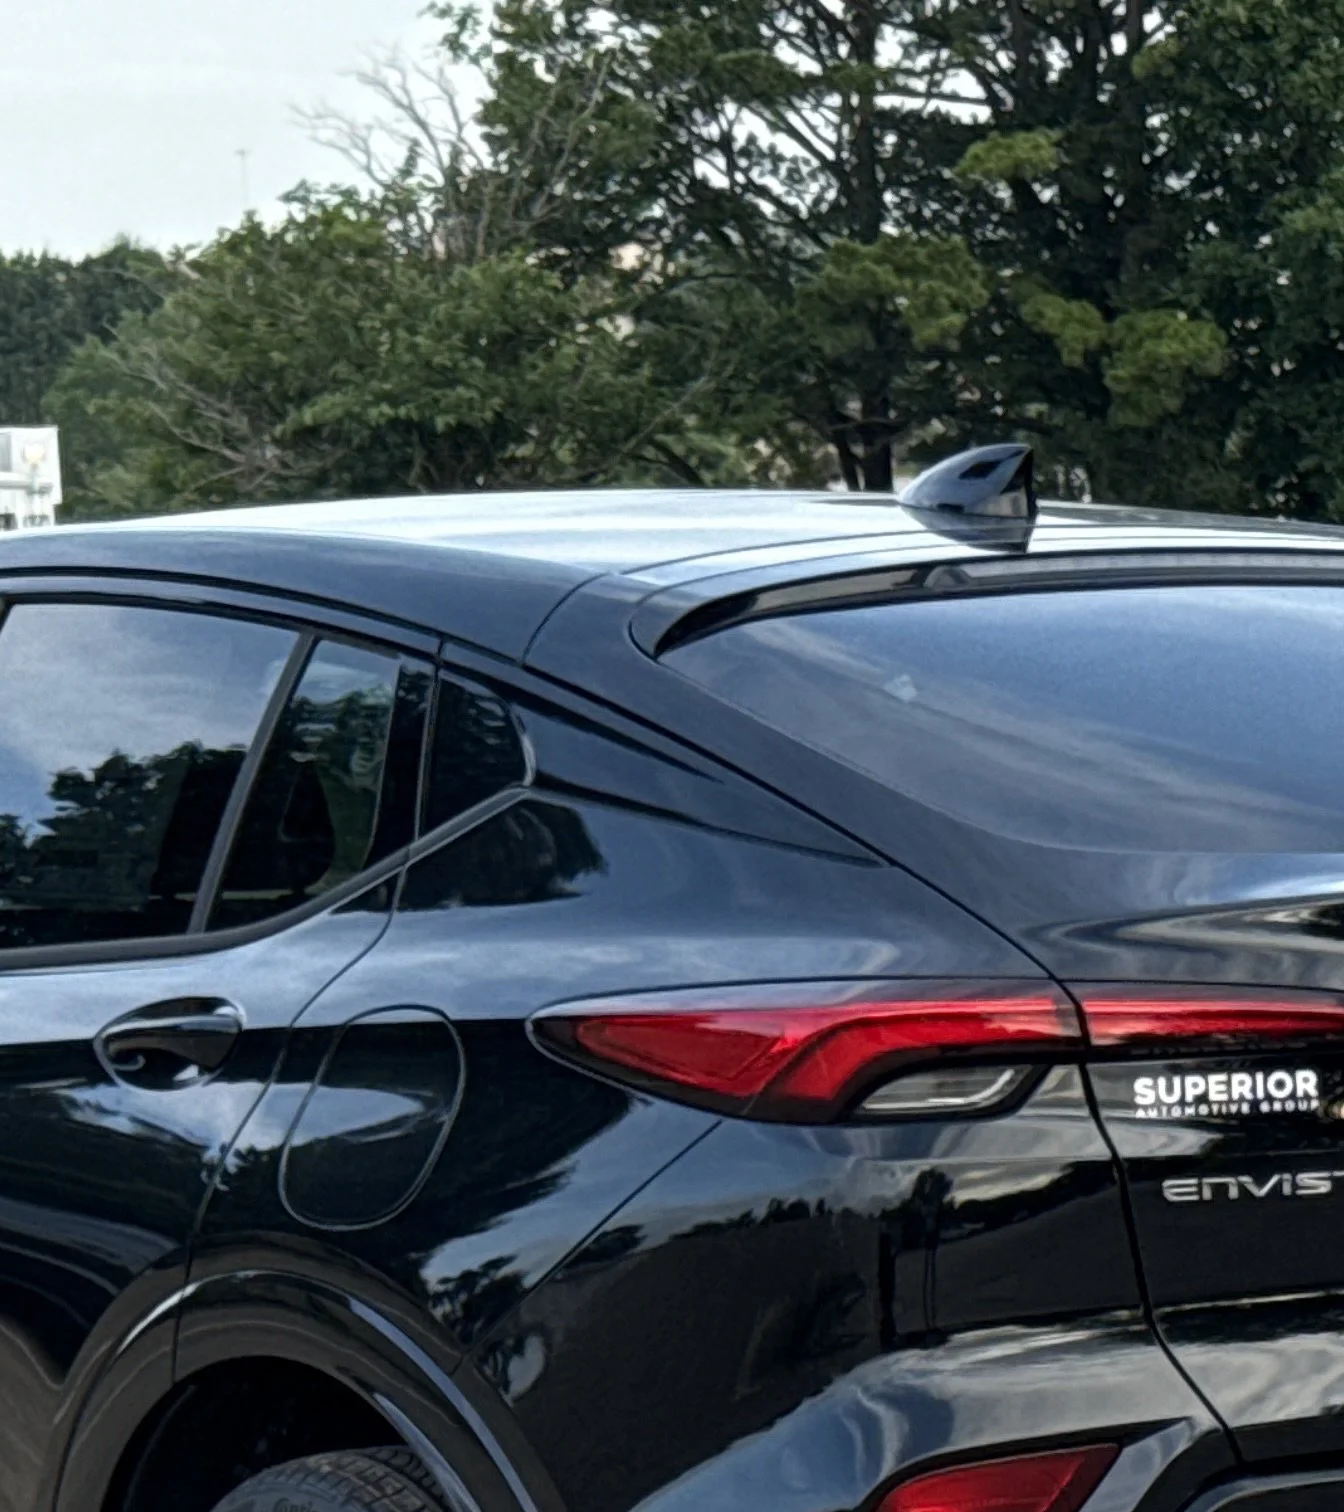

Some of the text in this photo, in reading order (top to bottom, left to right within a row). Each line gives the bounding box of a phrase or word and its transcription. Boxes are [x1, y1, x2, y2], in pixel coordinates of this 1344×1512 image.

[1133, 1069, 1319, 1105] SUPERIOR
[1136, 1099, 1321, 1119] AUTOMOTIVE GROUP
